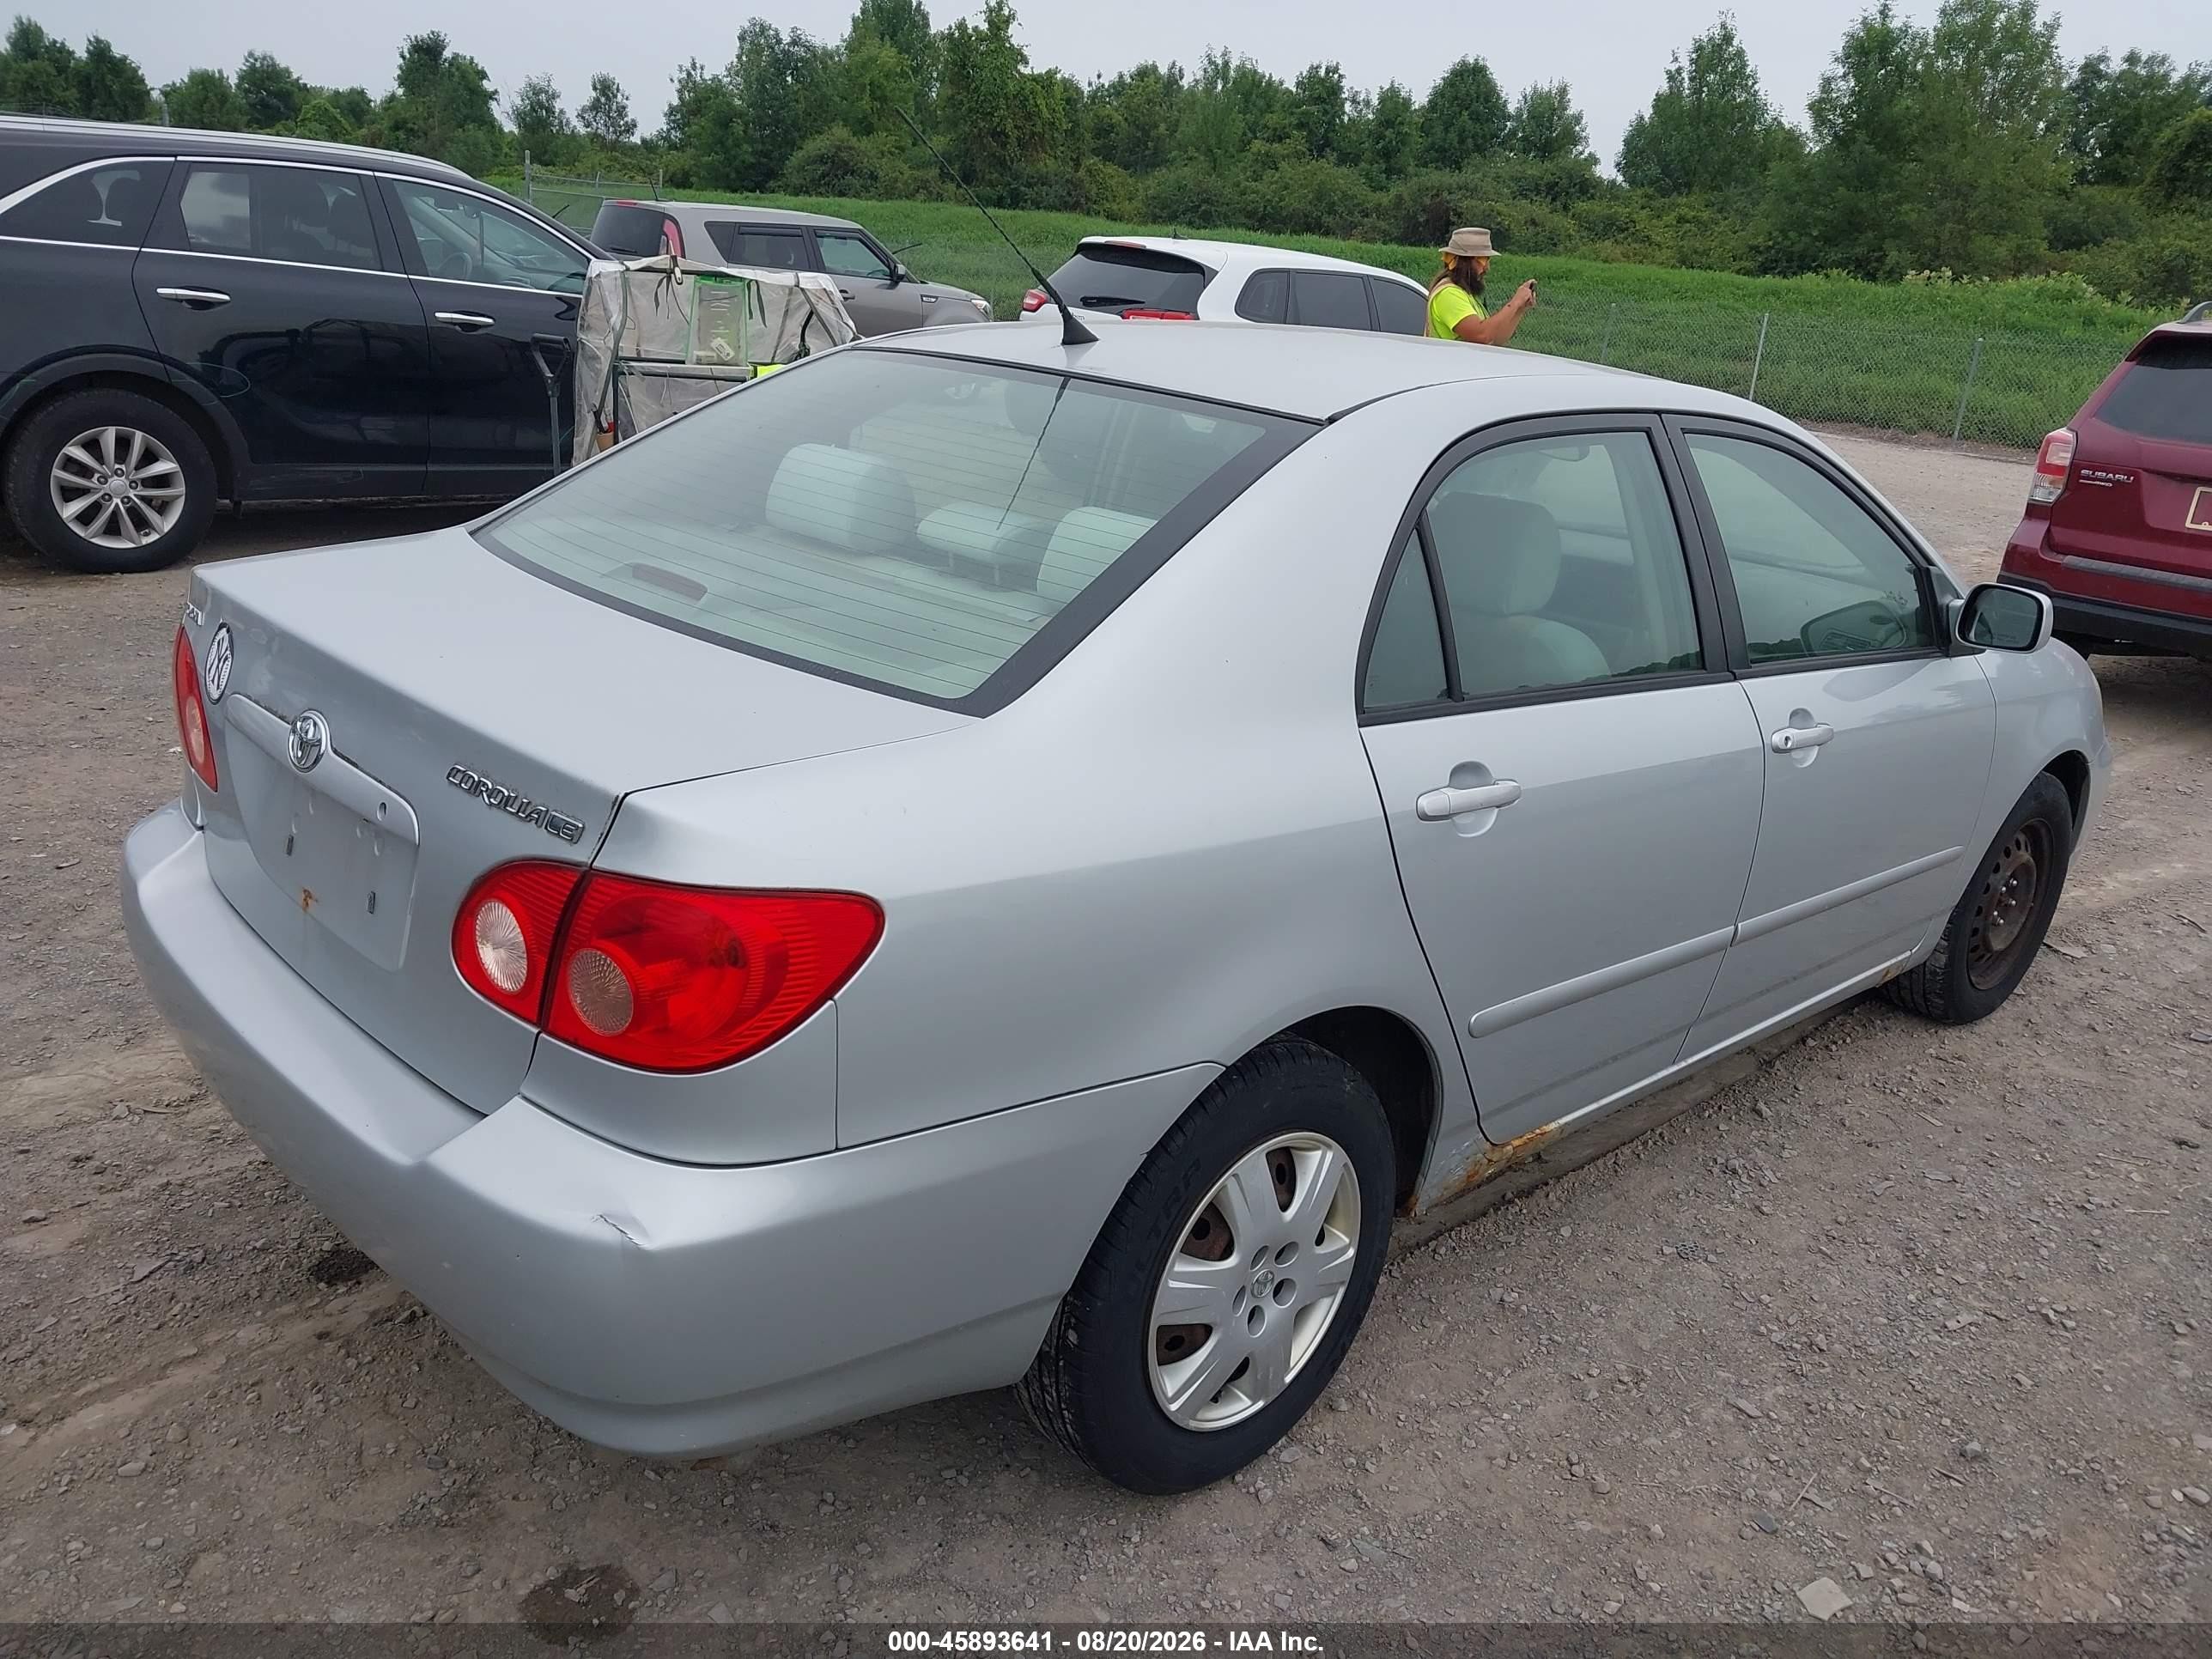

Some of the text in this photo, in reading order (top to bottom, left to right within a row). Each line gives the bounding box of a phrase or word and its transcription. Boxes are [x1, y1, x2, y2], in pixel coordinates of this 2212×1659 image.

[2081, 469, 2135, 483] SUBARU
[446, 763, 586, 844] COROLLA LE
